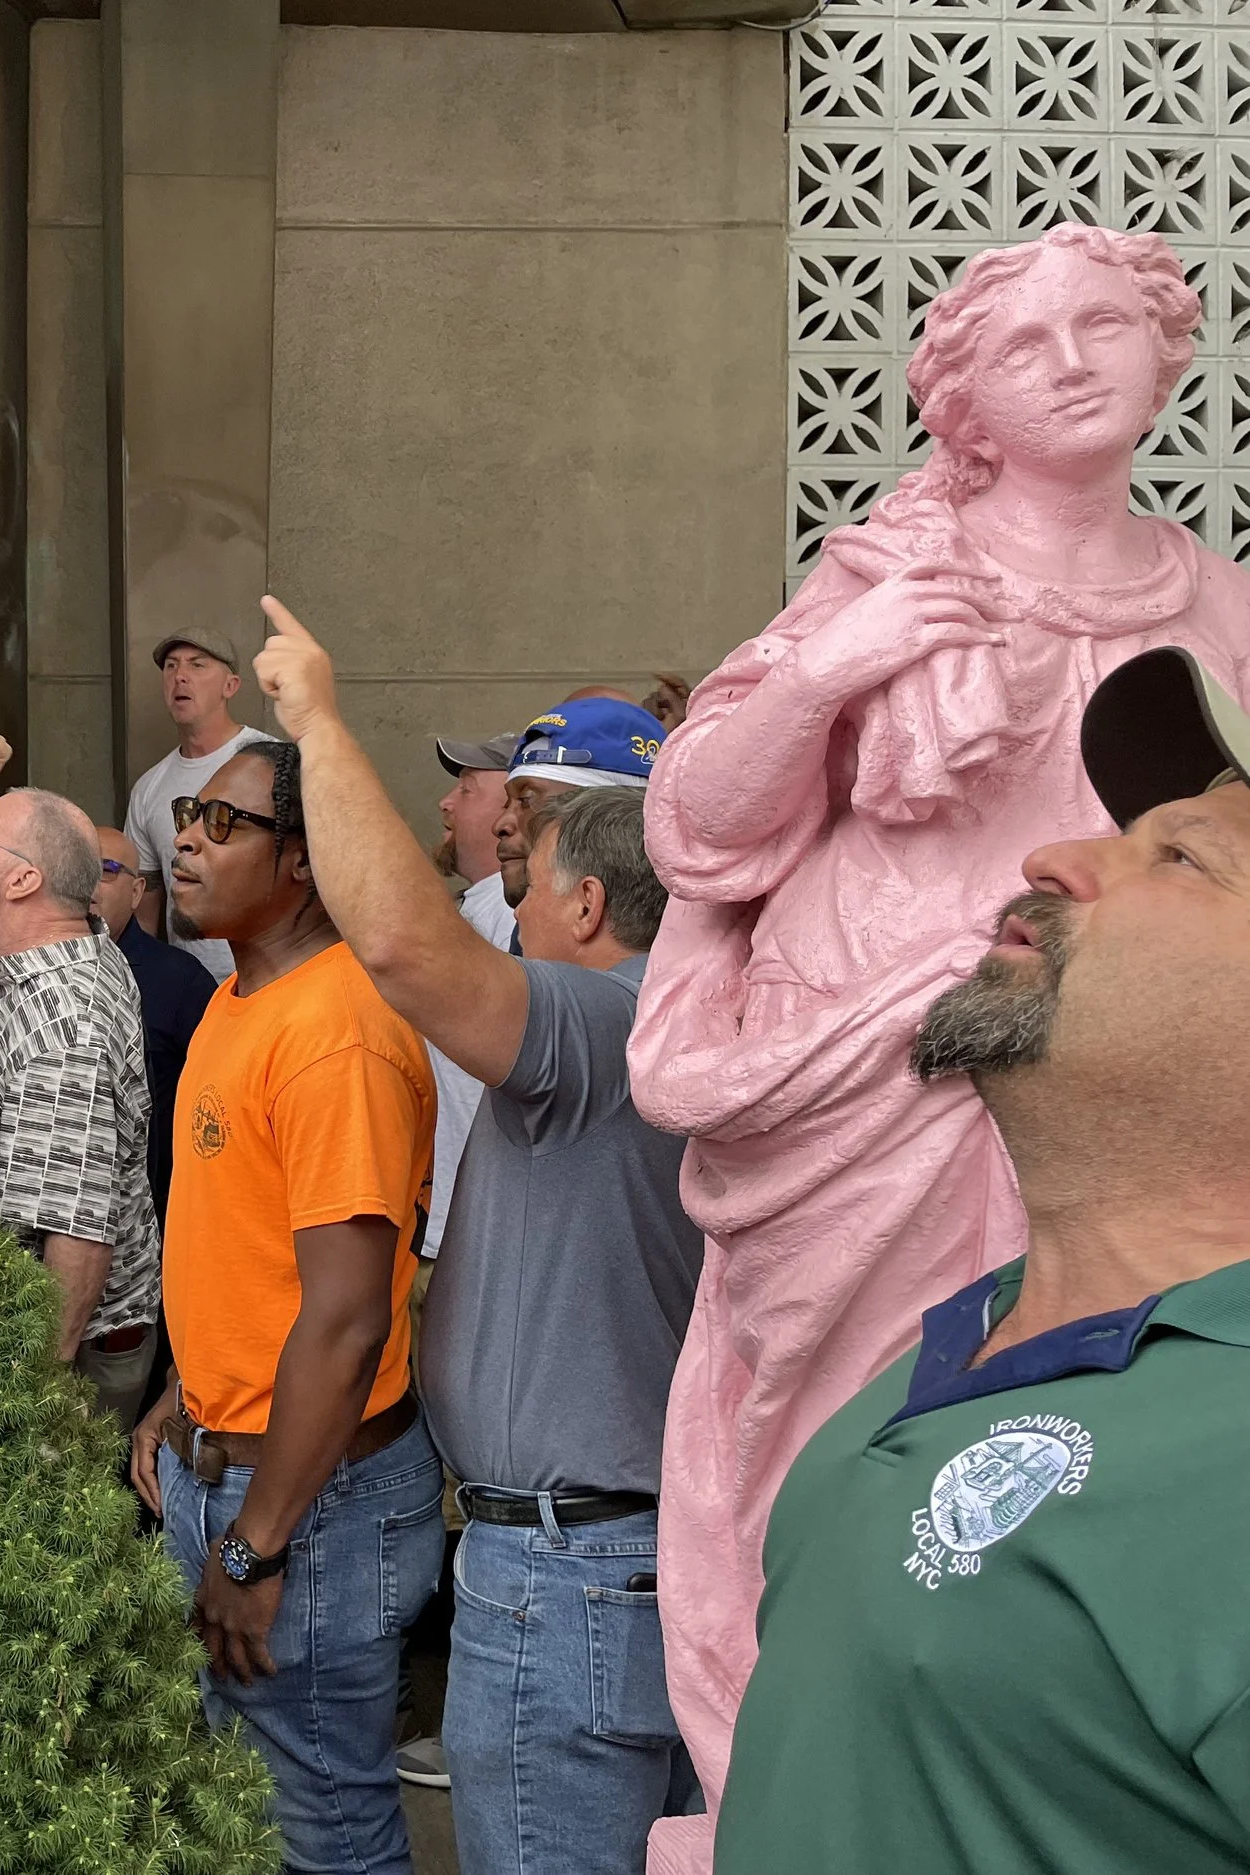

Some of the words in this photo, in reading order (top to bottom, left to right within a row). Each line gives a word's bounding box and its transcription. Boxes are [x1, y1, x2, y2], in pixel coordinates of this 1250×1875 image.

[990, 1414, 1093, 1495] IRONWORKERS
[904, 1553, 942, 1590] NYC
[912, 1508, 947, 1568] LOCAL
[947, 1553, 981, 1576] 580
